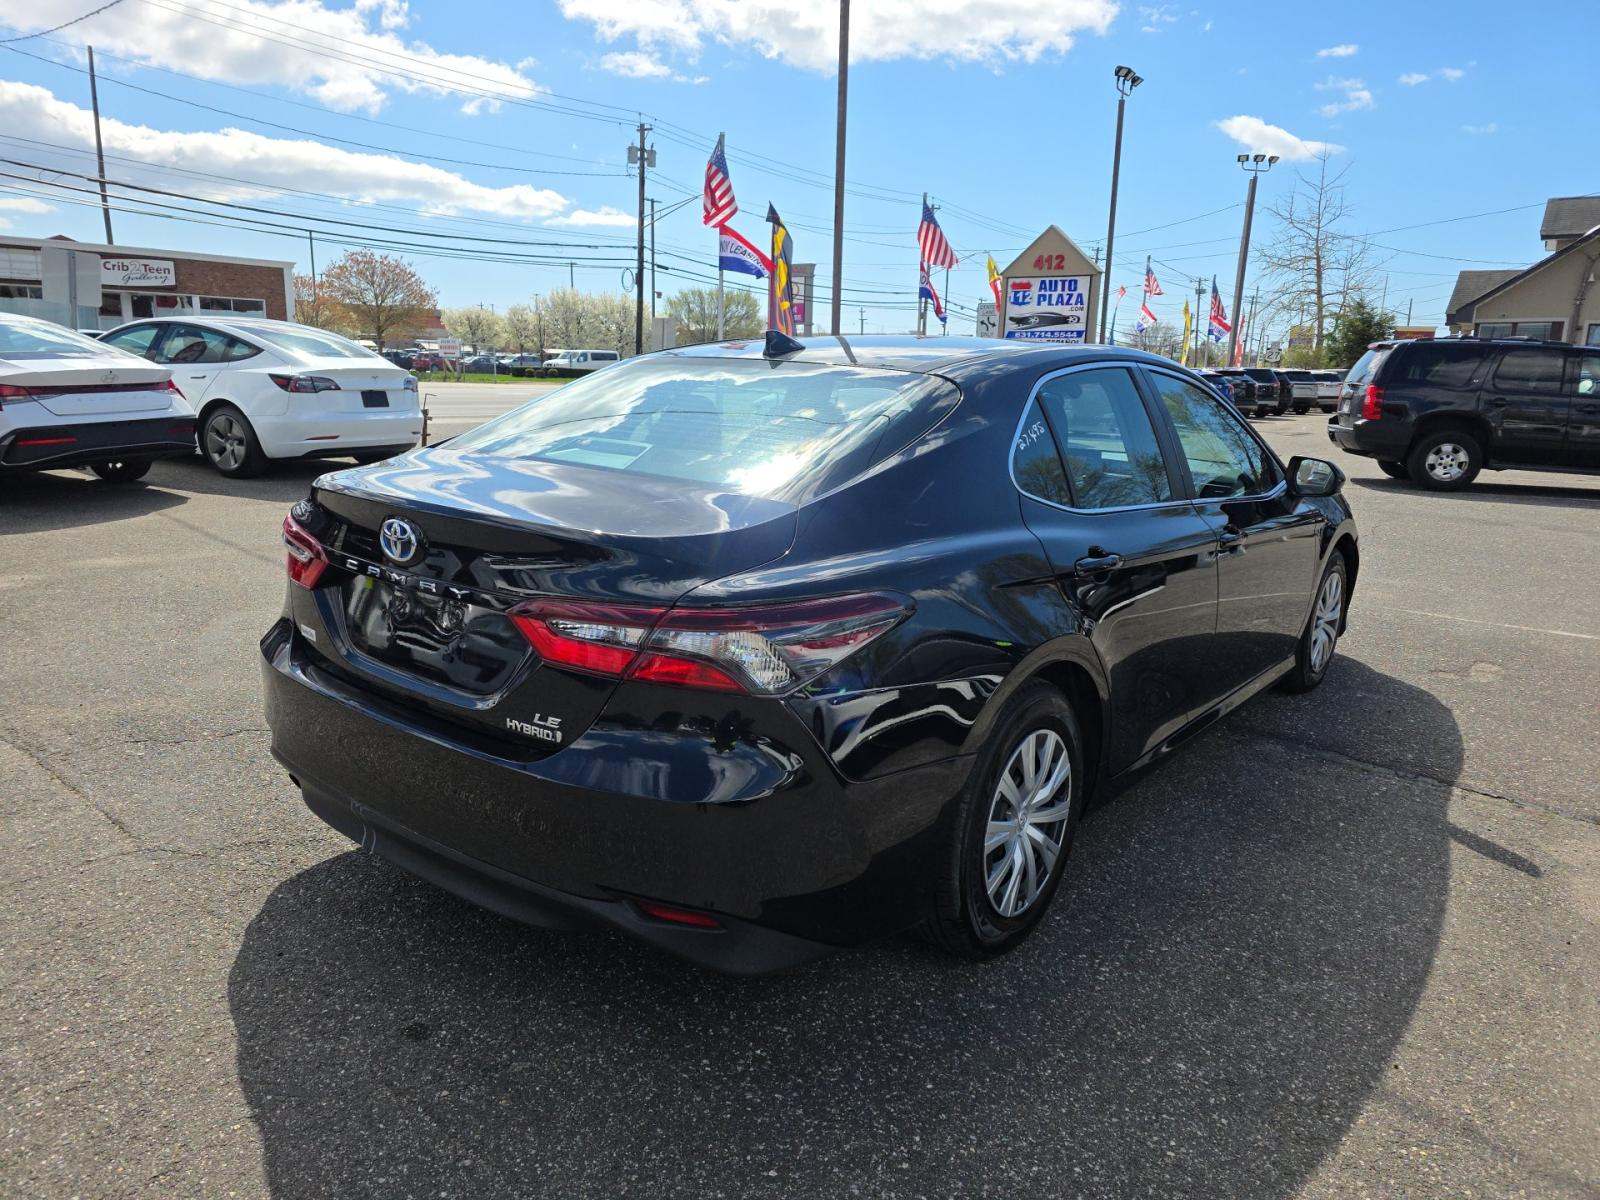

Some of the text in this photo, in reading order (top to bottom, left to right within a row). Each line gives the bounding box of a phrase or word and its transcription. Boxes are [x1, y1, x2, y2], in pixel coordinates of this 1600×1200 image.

[103, 261, 129, 271] Crib
[141, 264, 170, 274] Teen
[1033, 255, 1065, 271] 412
[1039, 279, 1078, 292] AUTO
[1036, 293, 1084, 306] PLAZA
[346, 559, 470, 599] CAMRY
[533, 713, 561, 728] LE
[506, 718, 554, 741] HYBRID
